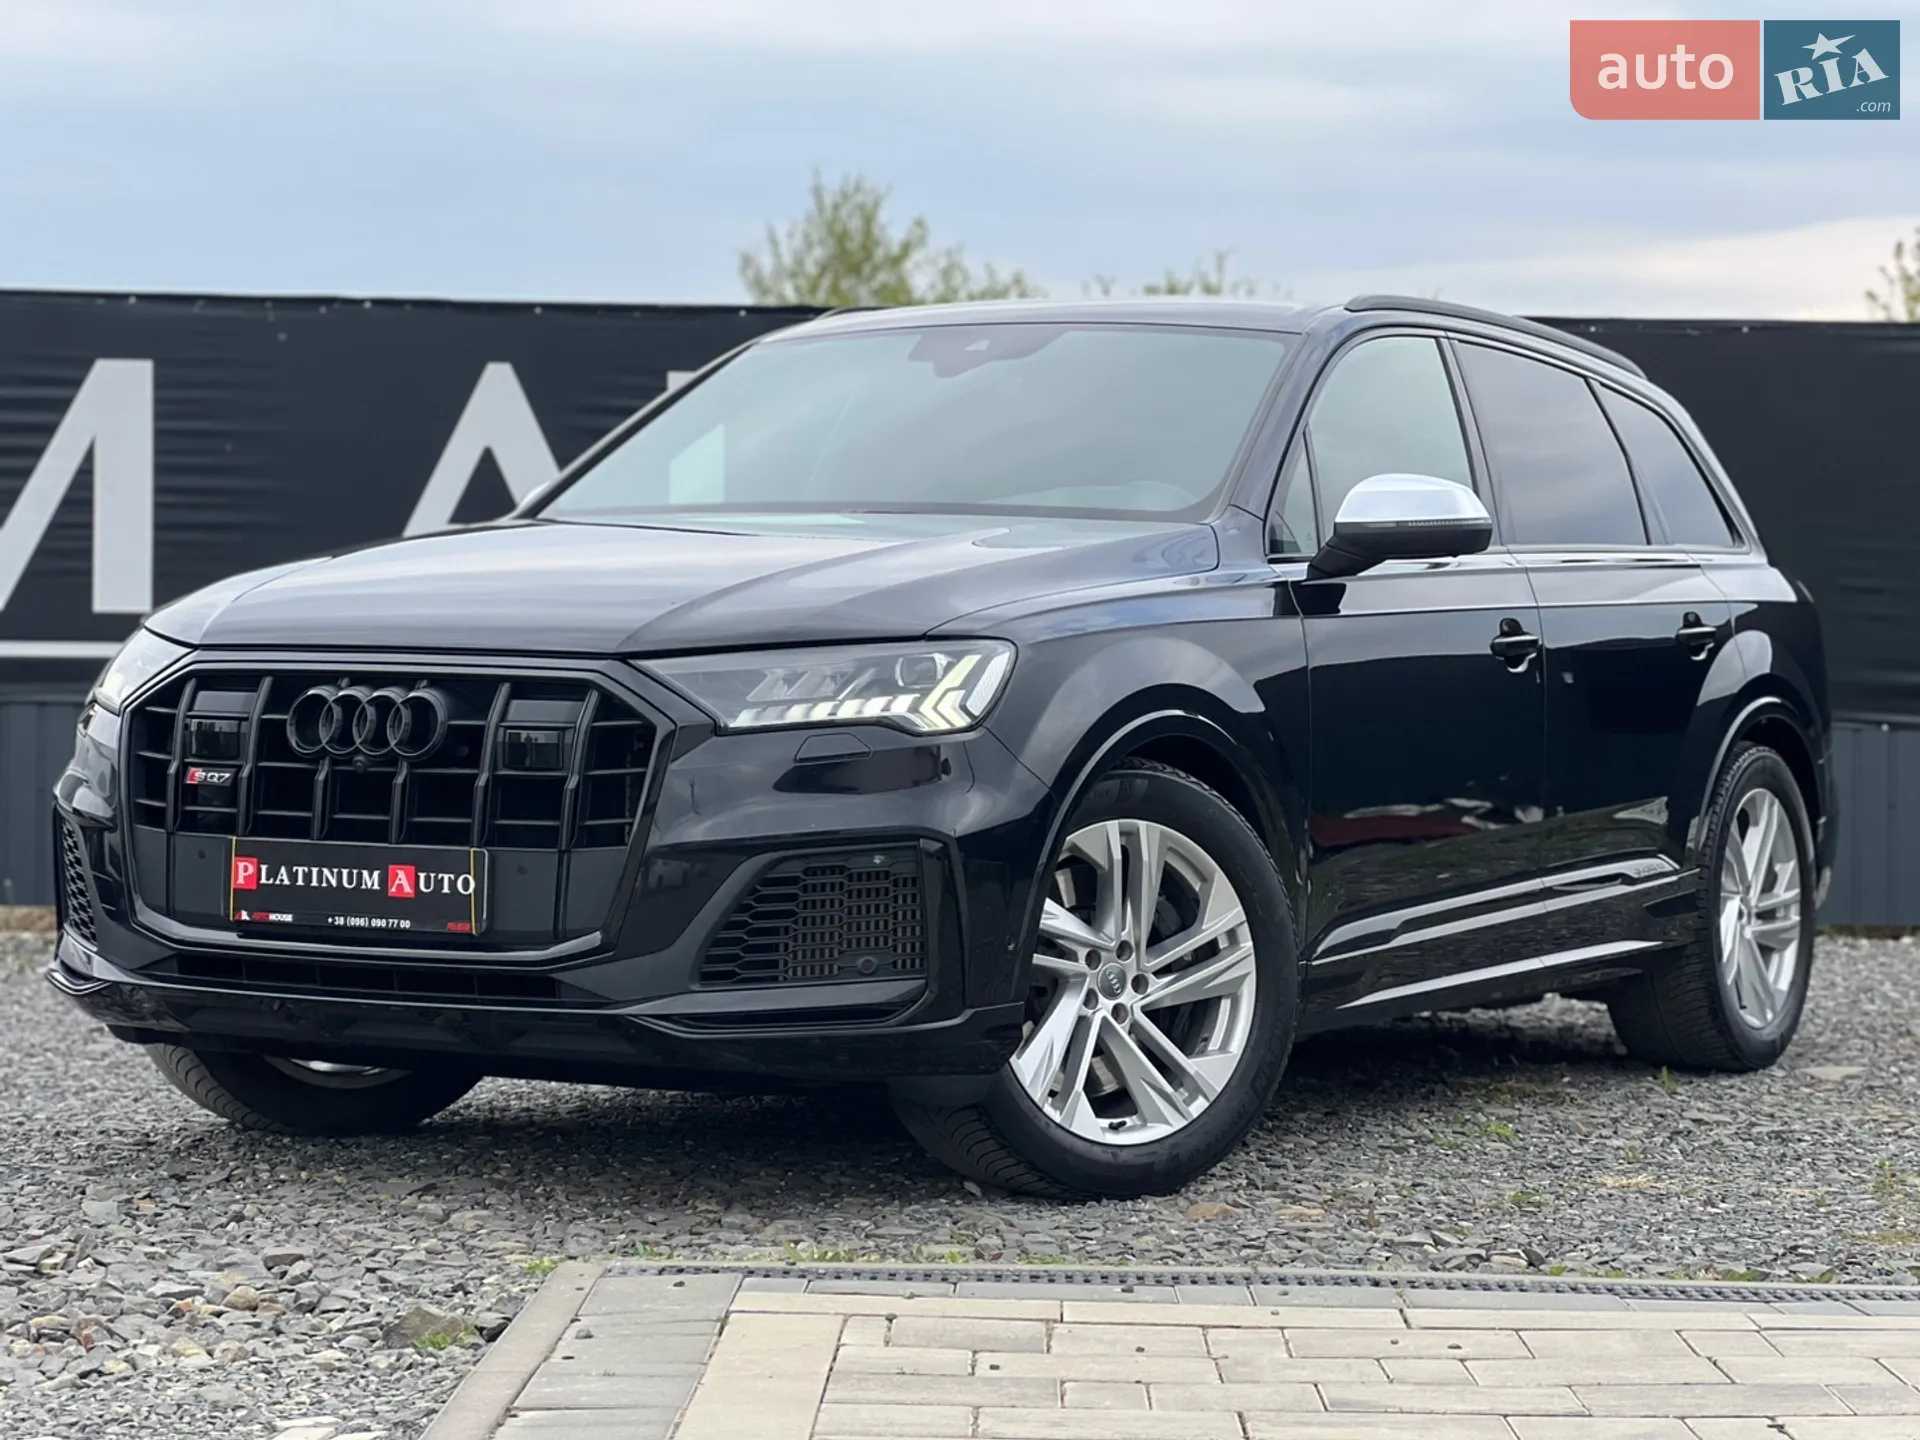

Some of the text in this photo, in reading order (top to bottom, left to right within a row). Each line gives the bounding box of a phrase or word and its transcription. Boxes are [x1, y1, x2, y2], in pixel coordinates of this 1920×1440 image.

[234, 858, 476, 898] PLATINUM AUTO
[388, 919, 399, 928] 77
[399, 920, 411, 929] 00
